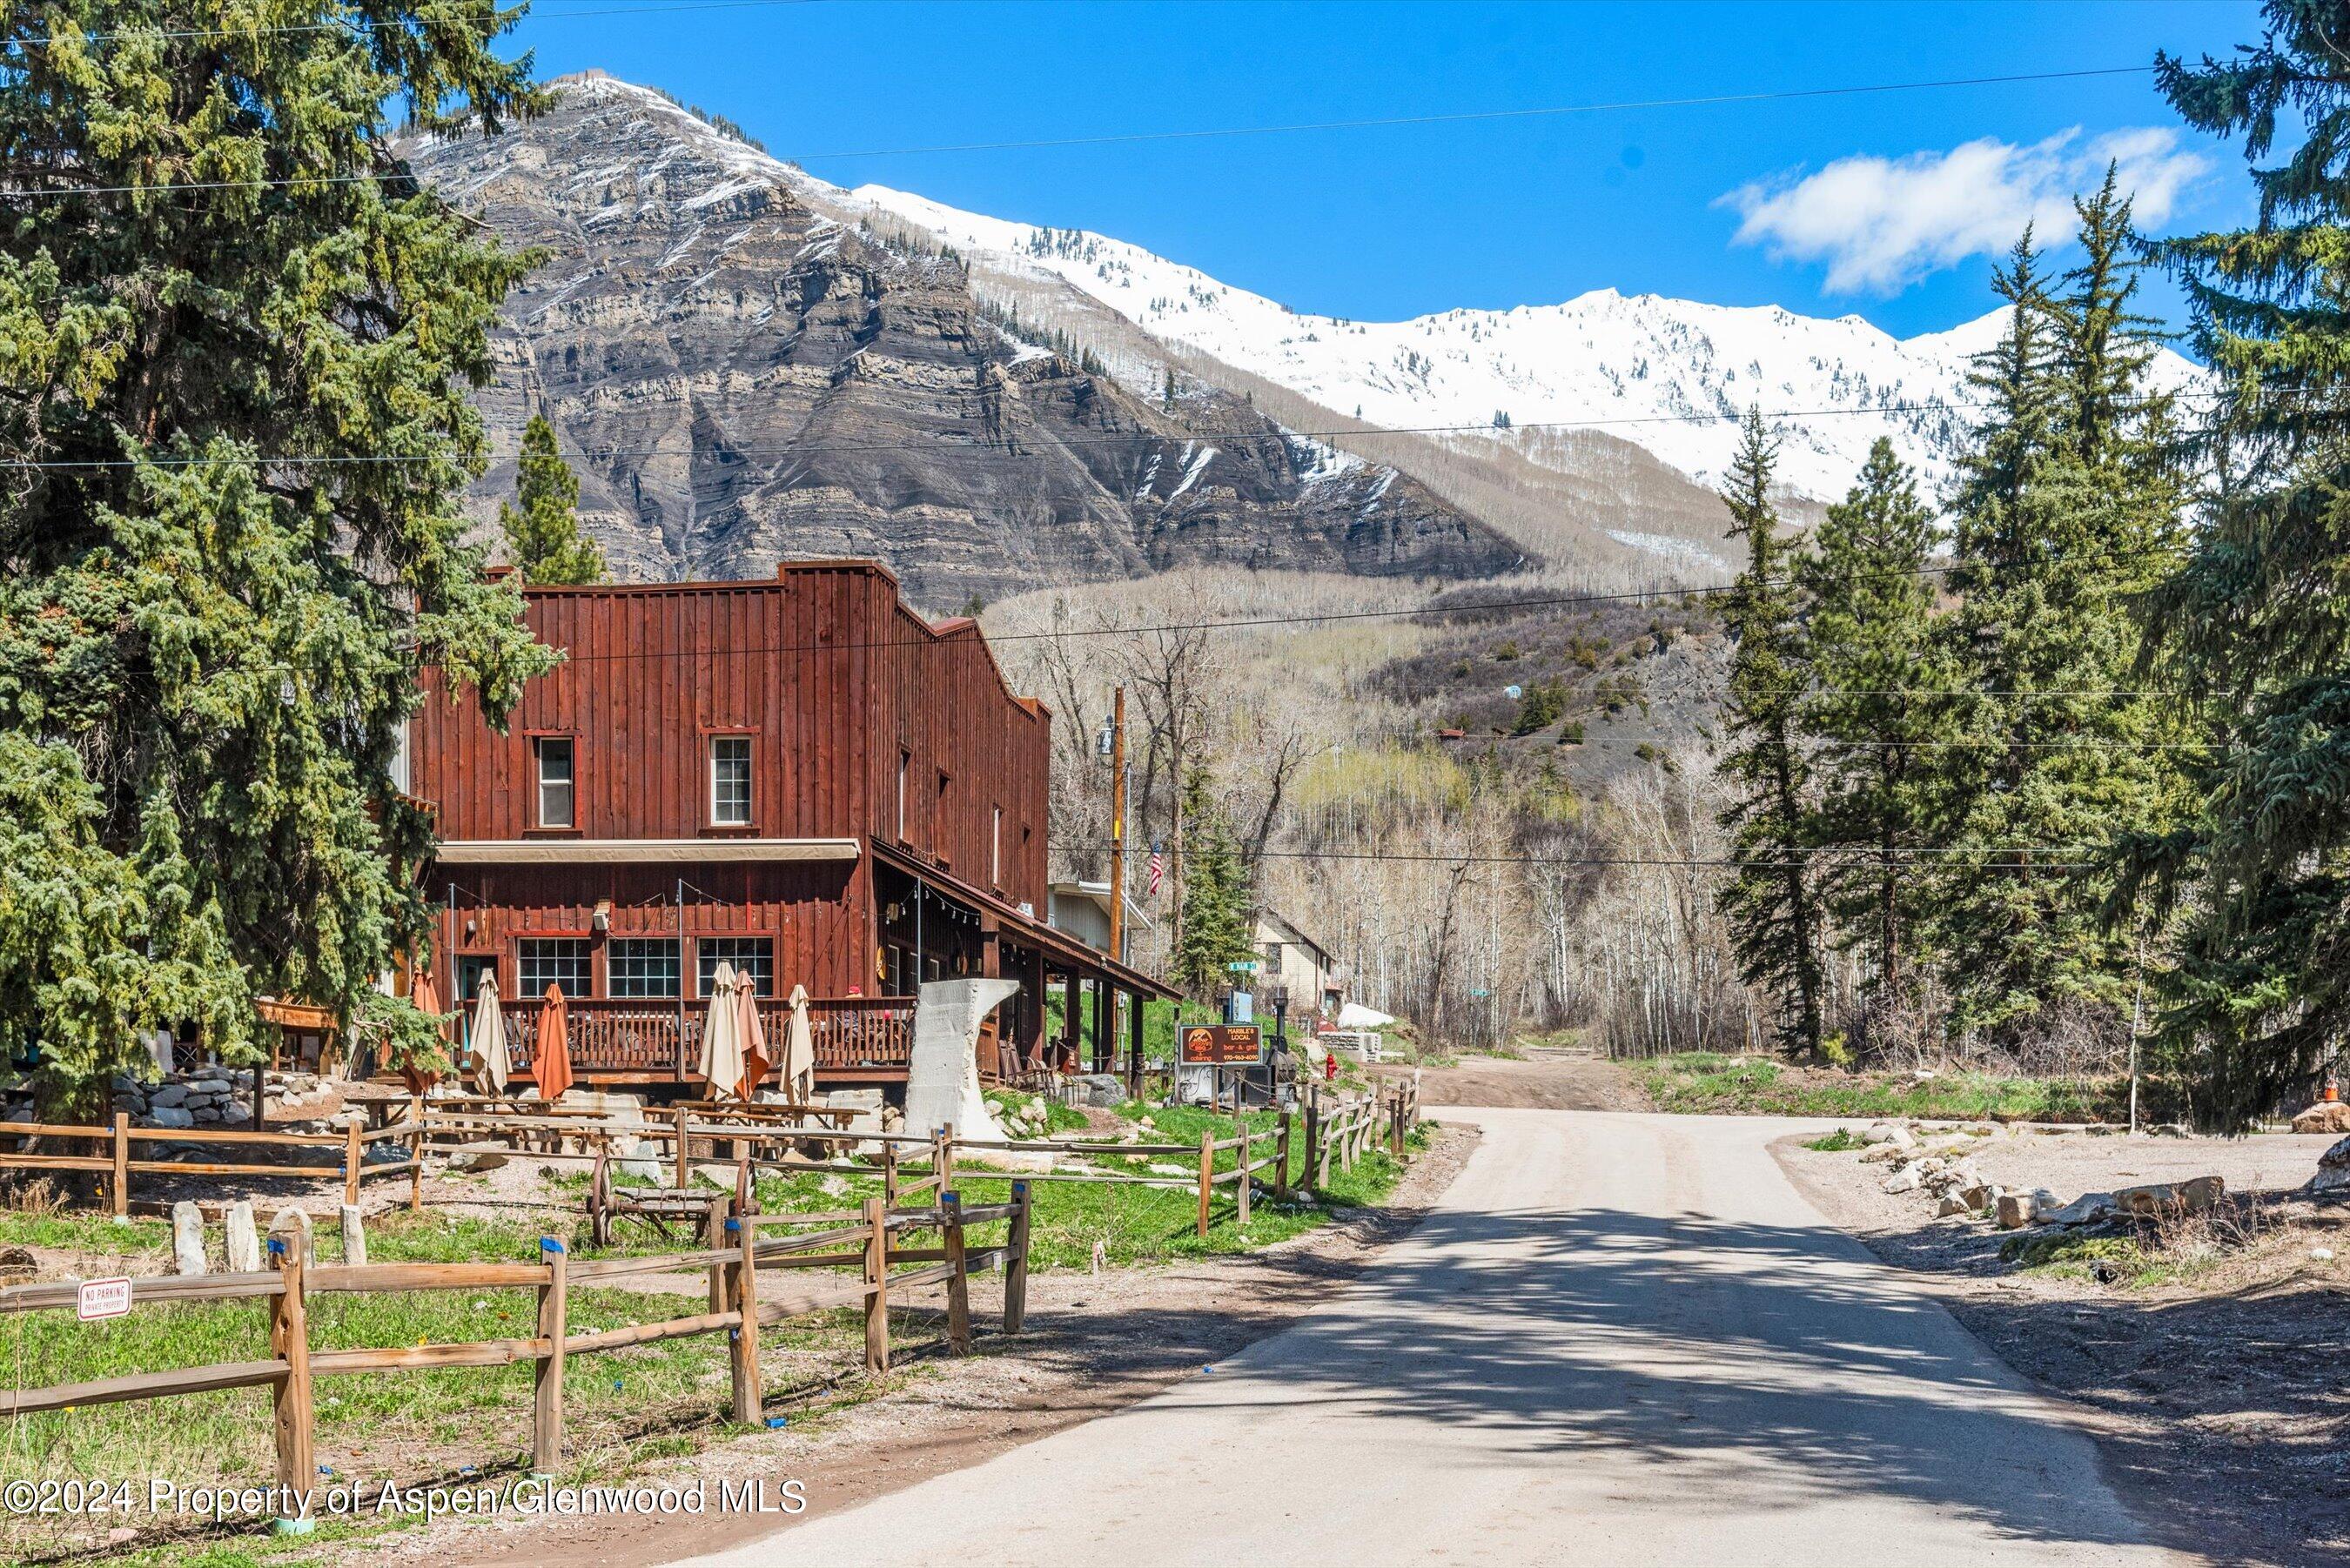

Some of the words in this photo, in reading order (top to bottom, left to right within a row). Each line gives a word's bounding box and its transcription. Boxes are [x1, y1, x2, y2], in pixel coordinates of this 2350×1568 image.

[1246, 1043, 1259, 1052] grill
[86, 1290, 95, 1302] NO
[97, 1286, 124, 1300] PARKING
[85, 1303, 102, 1312] PRIVATE
[103, 1300, 124, 1310] PROPERTY
